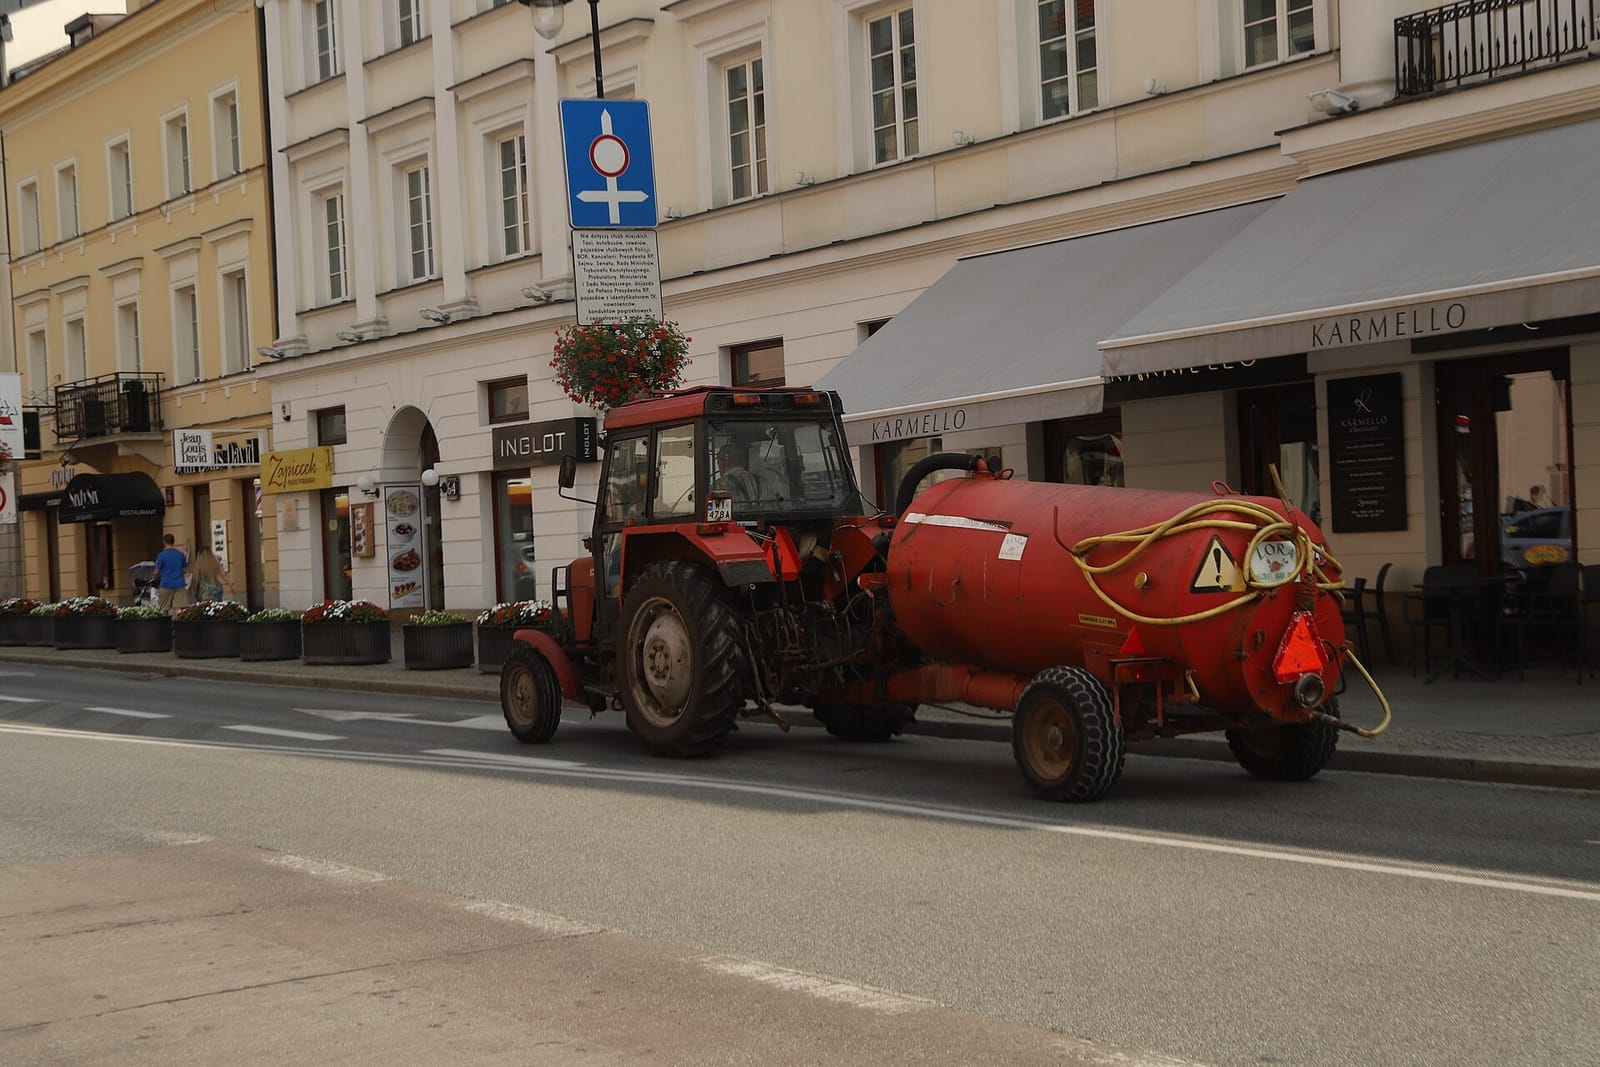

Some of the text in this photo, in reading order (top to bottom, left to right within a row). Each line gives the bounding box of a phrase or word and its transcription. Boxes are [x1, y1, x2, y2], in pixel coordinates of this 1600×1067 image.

[1312, 302, 1466, 348] KARMELLO
[872, 410, 966, 441] KARMELLO
[1341, 416, 1388, 428] KARMELLO
[180, 432, 202, 443] Jean
[182, 442, 206, 454] Louis
[500, 432, 566, 456] INGLOT
[182, 452, 207, 463] David
[268, 452, 318, 488] Zapiecek
[709, 510, 730, 518] 478A
